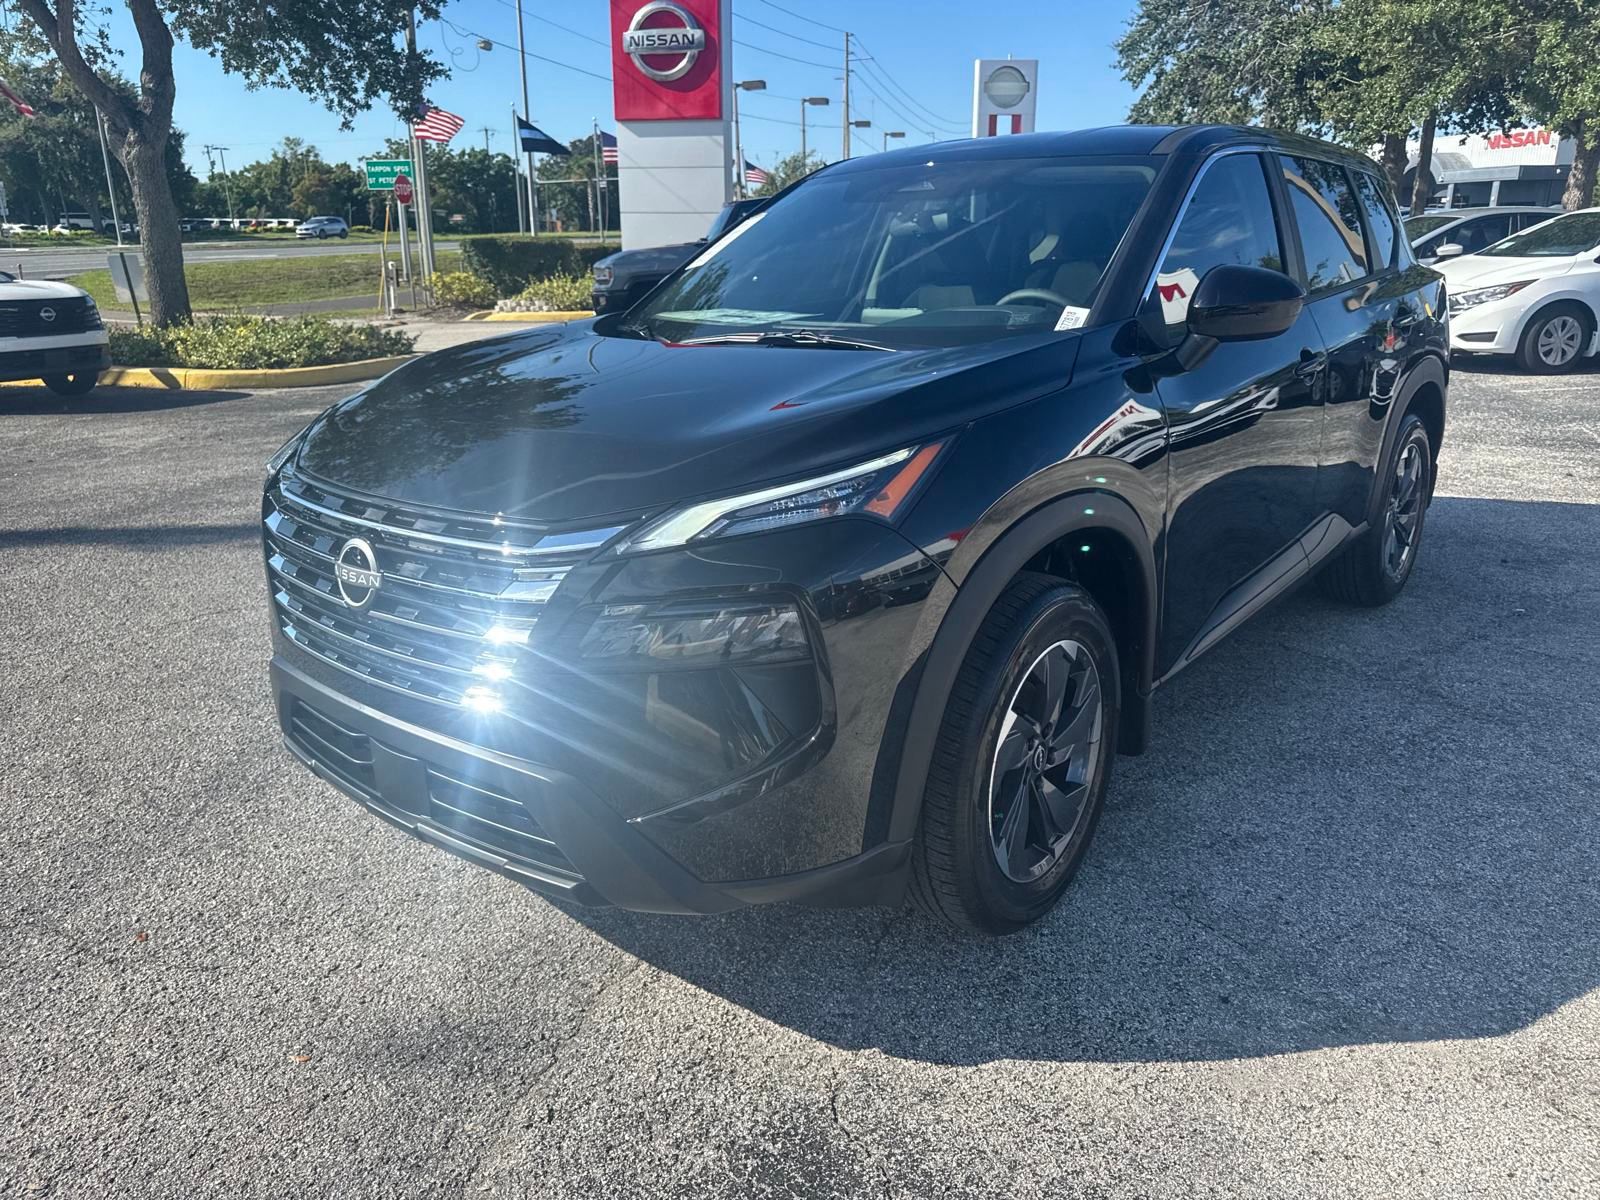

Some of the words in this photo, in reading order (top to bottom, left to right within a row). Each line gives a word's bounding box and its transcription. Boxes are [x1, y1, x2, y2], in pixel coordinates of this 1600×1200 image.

[629, 33, 695, 48] NISSAN
[1487, 130, 1552, 150] NISSAN
[368, 165, 391, 173] TARPON
[395, 183, 412, 196] STOP
